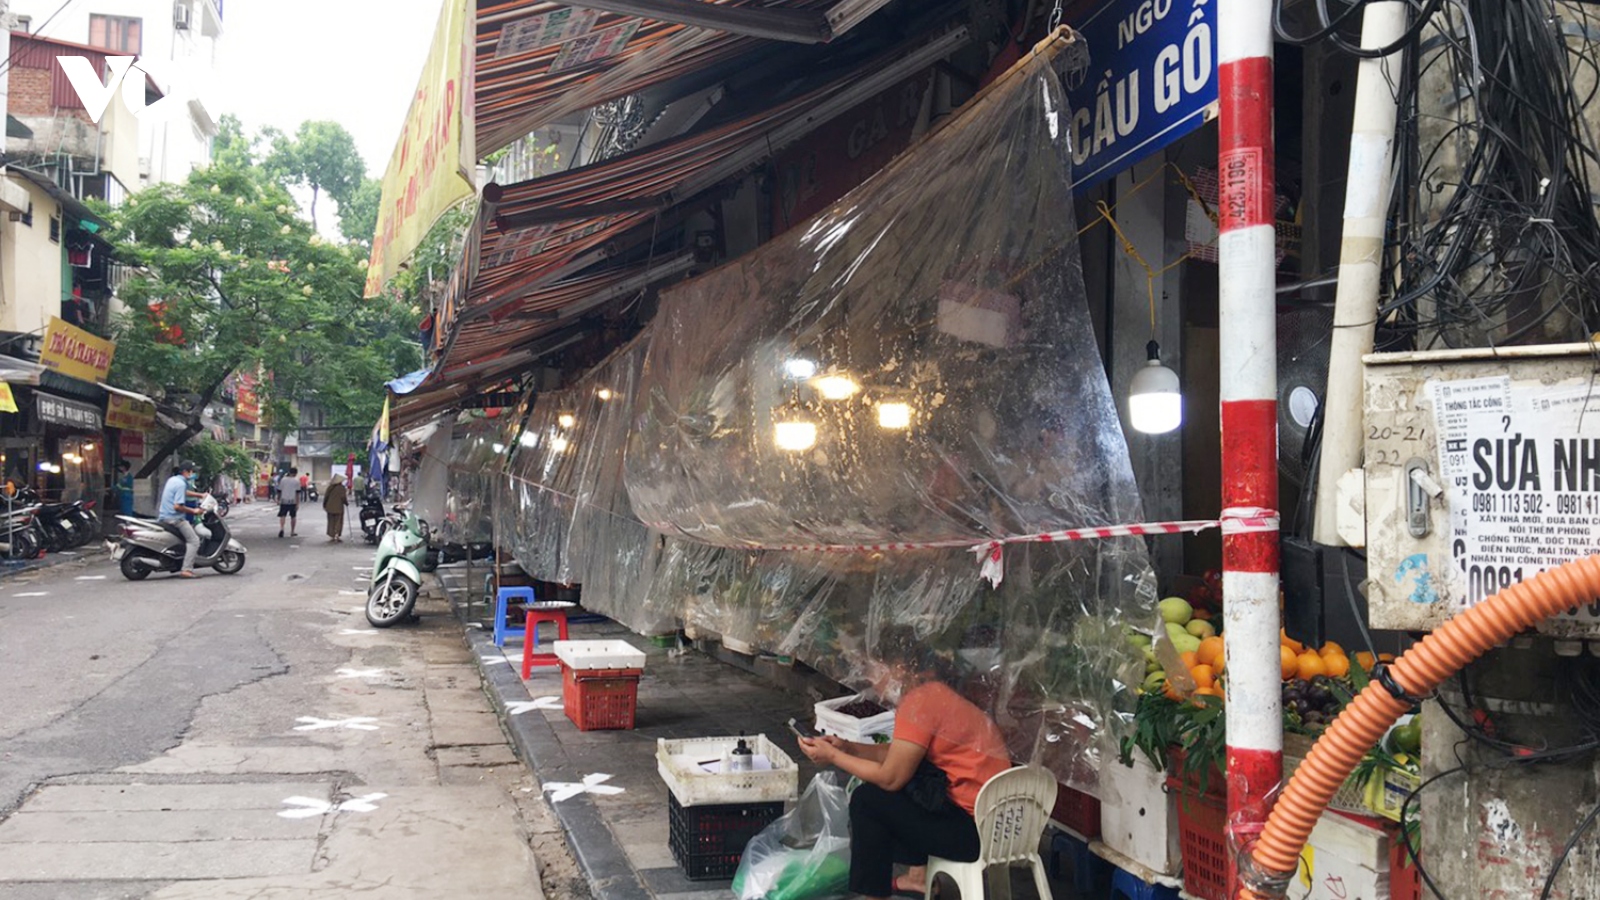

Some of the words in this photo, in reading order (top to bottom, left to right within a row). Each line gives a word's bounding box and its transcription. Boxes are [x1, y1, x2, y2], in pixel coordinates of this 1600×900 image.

[1071, 68, 1139, 166] CẦU
[1472, 415, 1541, 491] SỬA
[1473, 493, 1496, 513] 0981
[1502, 493, 1520, 513] 113
[1523, 493, 1543, 514] 502
[1557, 494, 1582, 514] 0981
[1500, 555, 1514, 563] THI
